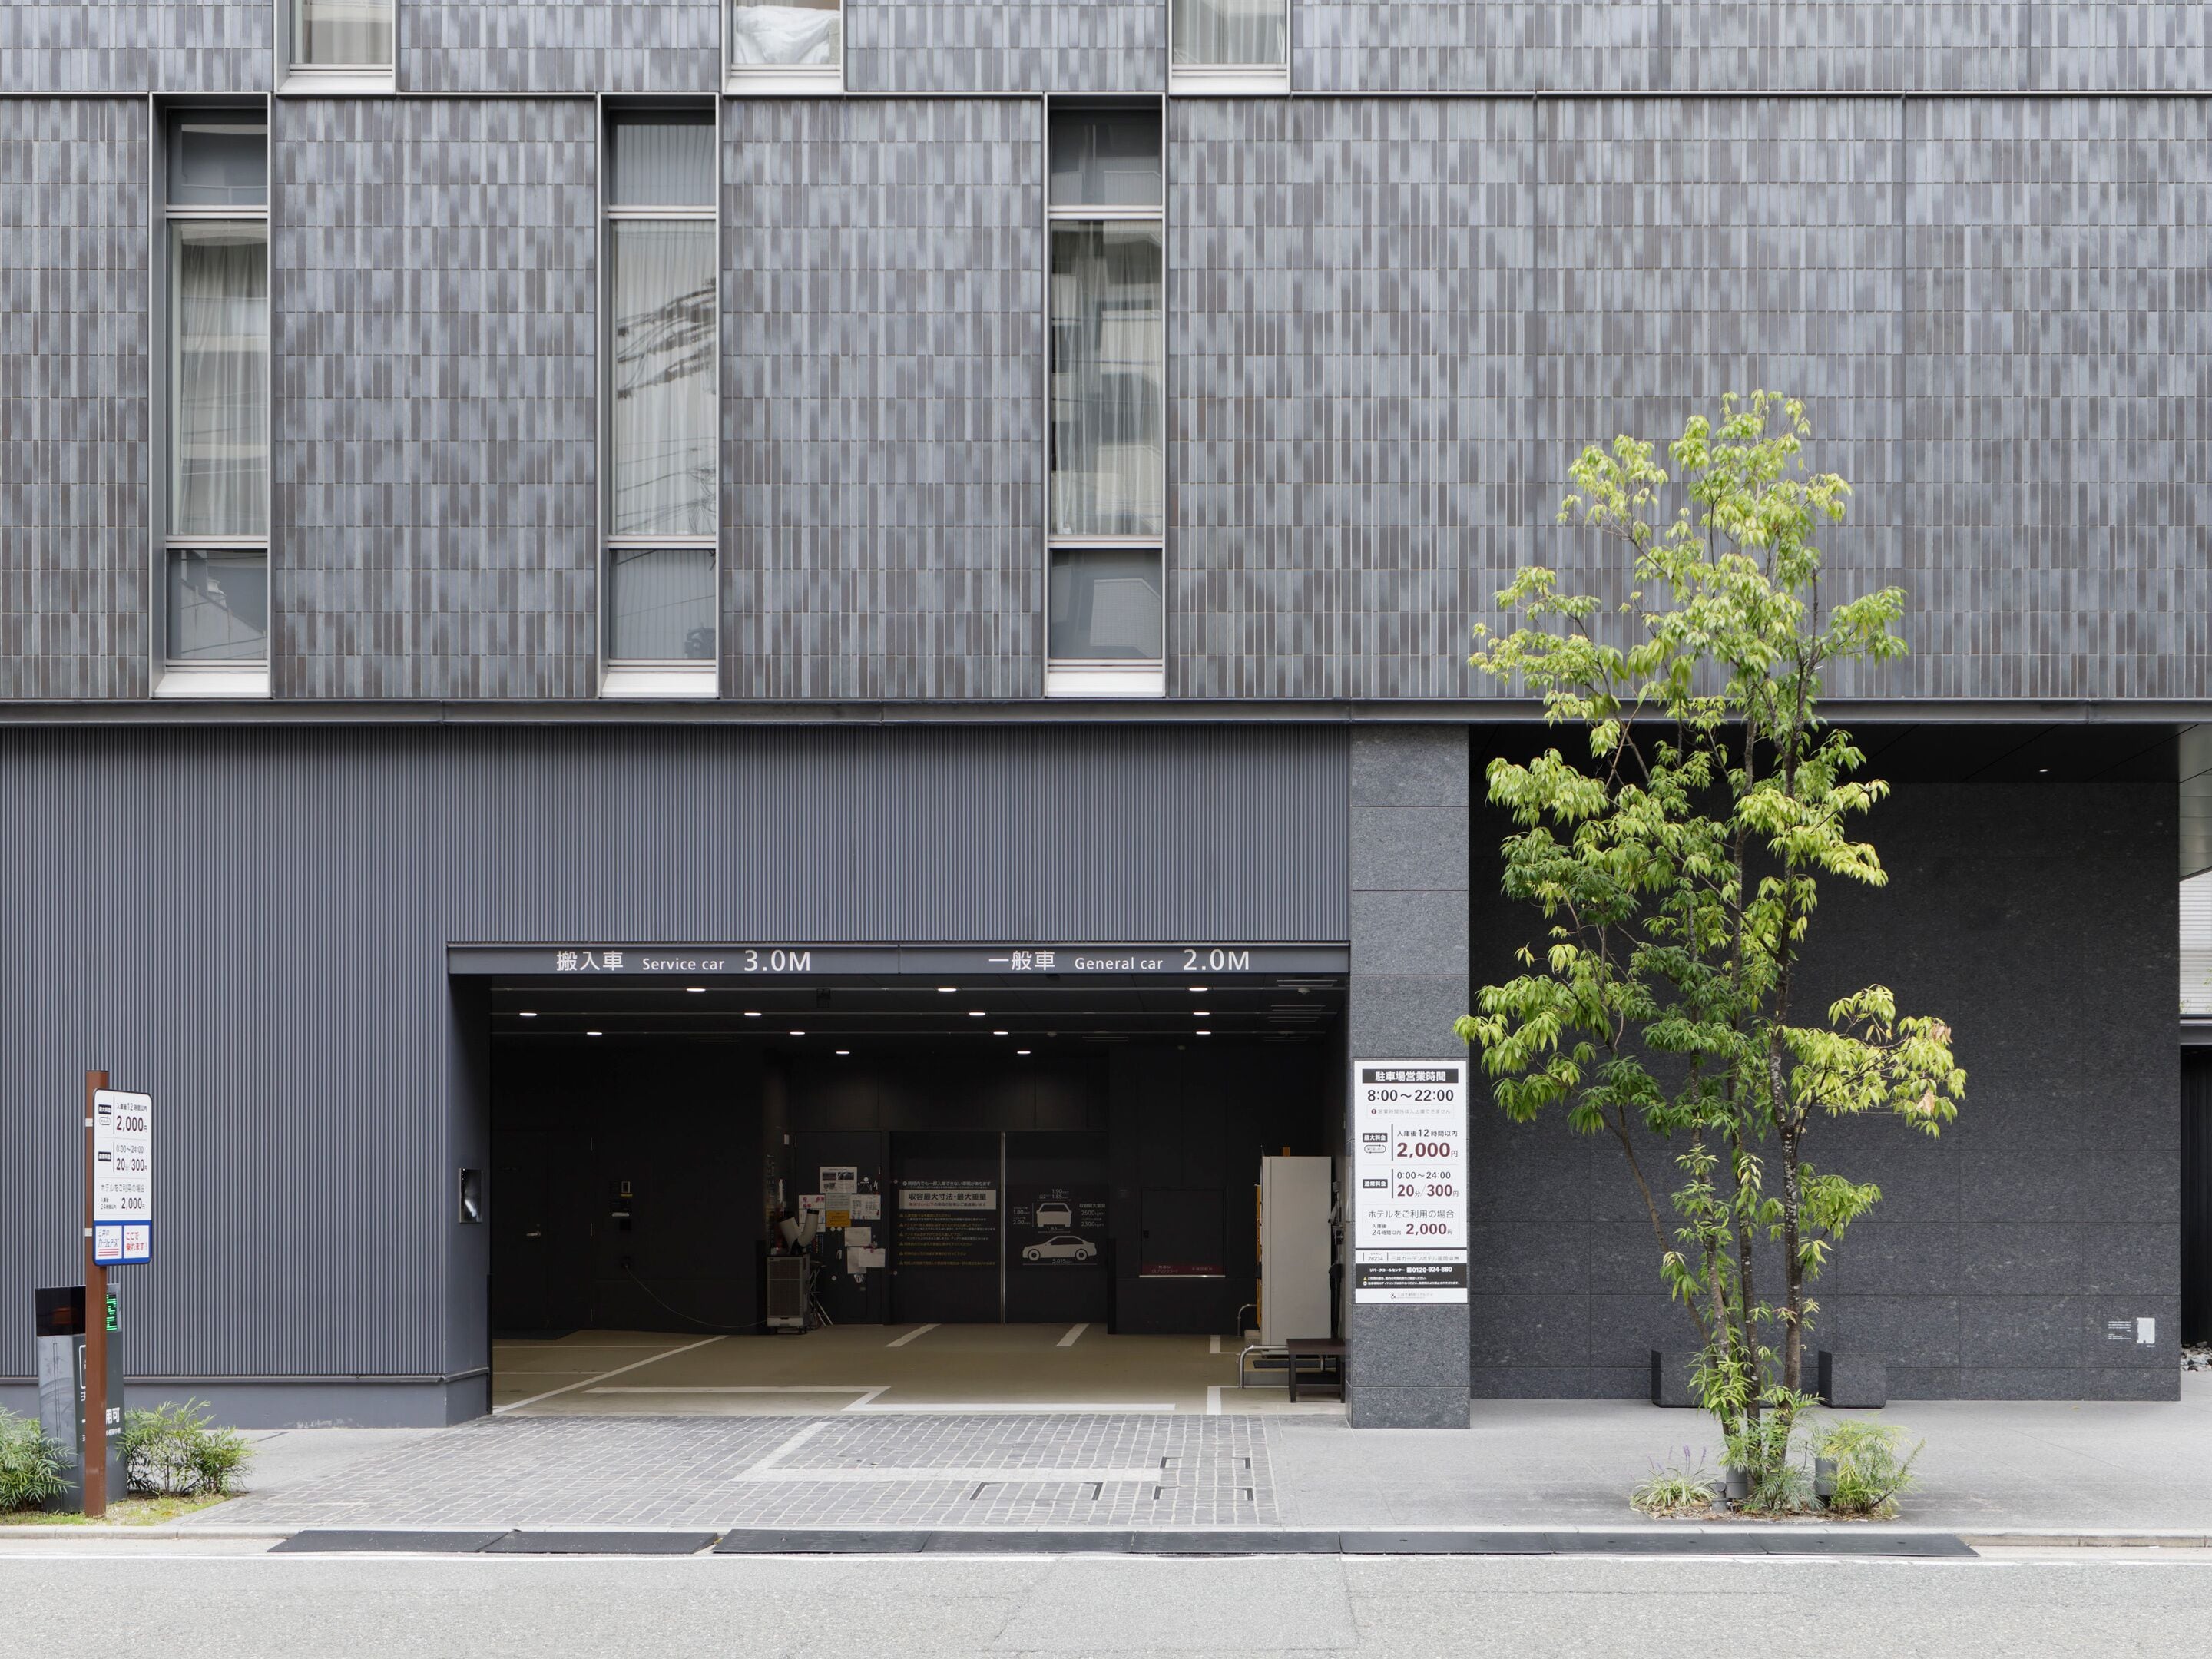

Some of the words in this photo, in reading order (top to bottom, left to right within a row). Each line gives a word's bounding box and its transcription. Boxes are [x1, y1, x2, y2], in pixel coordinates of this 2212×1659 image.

[556, 951, 624, 971] 搬入車
[643, 958, 696, 971] Service
[702, 960, 724, 971] car
[744, 949, 811, 972] 3.0M
[988, 951, 1055, 970] 一般車
[1075, 957, 1134, 970] General
[1141, 959, 1163, 970] car
[1183, 949, 1250, 971] 2.0M
[1375, 1071, 1446, 1081] 駐車場営業時間
[1368, 1210, 1455, 1219] ホテルをご利用の場合
